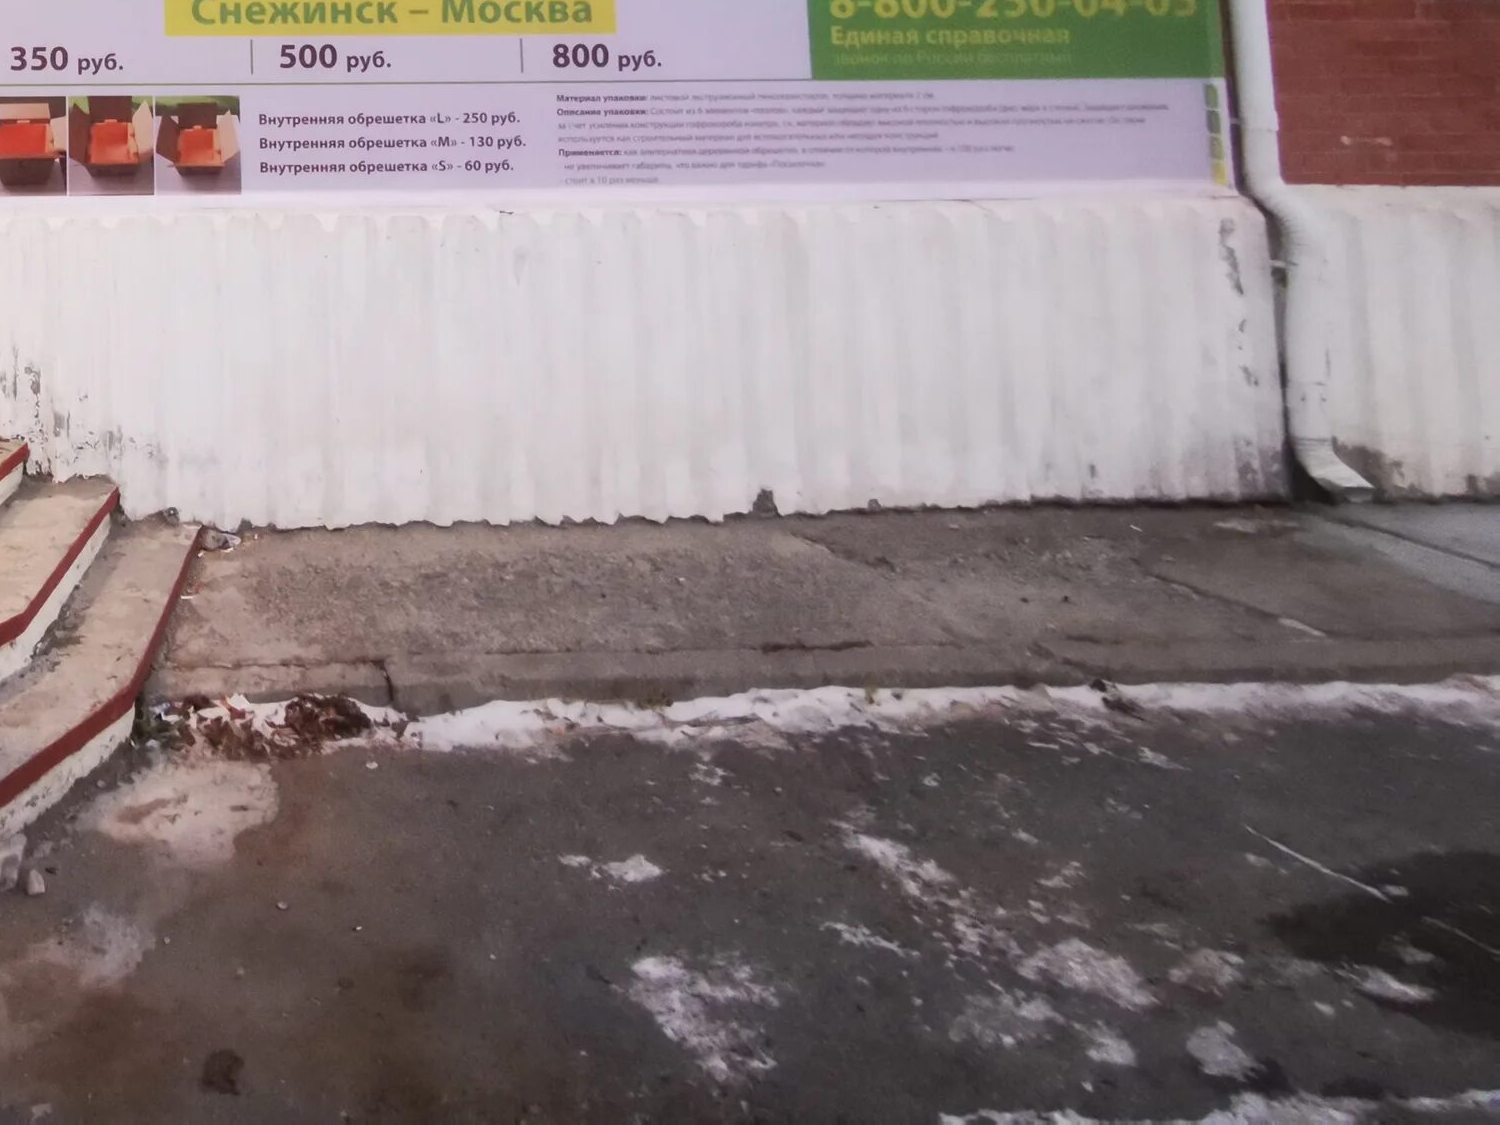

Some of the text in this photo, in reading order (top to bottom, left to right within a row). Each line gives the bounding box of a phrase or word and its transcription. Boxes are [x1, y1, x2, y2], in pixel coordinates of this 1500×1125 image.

[830, 25, 1070, 48] Единая справочная
[10, 45, 124, 75] 350 руб.
[279, 43, 392, 73] 500 руб.
[552, 43, 662, 73] 800 руб.
[258, 113, 344, 128] Внутренняя
[347, 112, 426, 127] обрешетка
[429, 113, 452, 124] «L»
[462, 112, 489, 124] 250
[491, 112, 520, 128] руб.
[259, 137, 346, 152] Внутренняя
[348, 136, 428, 151] обрешетка
[431, 136, 458, 148] «M»
[468, 136, 494, 148] 130
[497, 136, 527, 151] руб.
[260, 161, 346, 177] Внутренняя
[349, 160, 428, 176] обрешетка
[431, 160, 454, 172] «S»
[464, 160, 482, 172] 60
[485, 160, 514, 175] руб.
